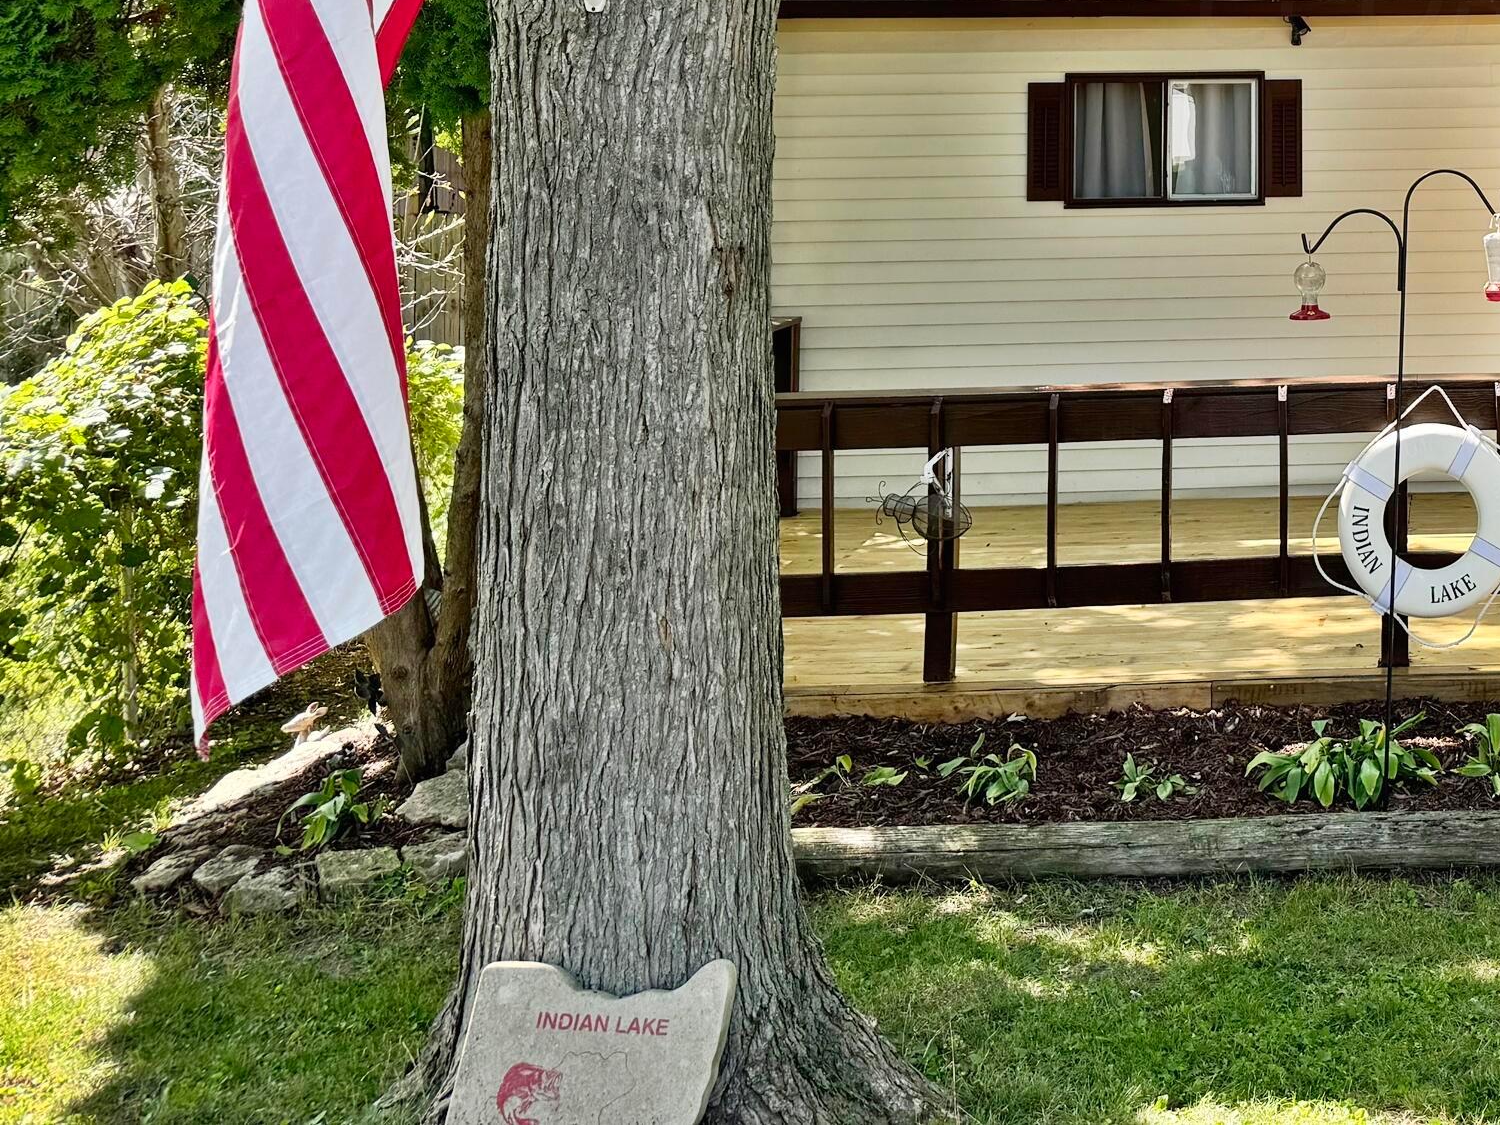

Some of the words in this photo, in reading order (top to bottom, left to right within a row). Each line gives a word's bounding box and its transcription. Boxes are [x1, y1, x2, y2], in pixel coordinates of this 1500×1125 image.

[1352, 505, 1384, 575] INDIAN
[1430, 573, 1477, 604] LAKE
[535, 1011, 610, 1033] INDIAN
[615, 1016, 670, 1036] LAKE
